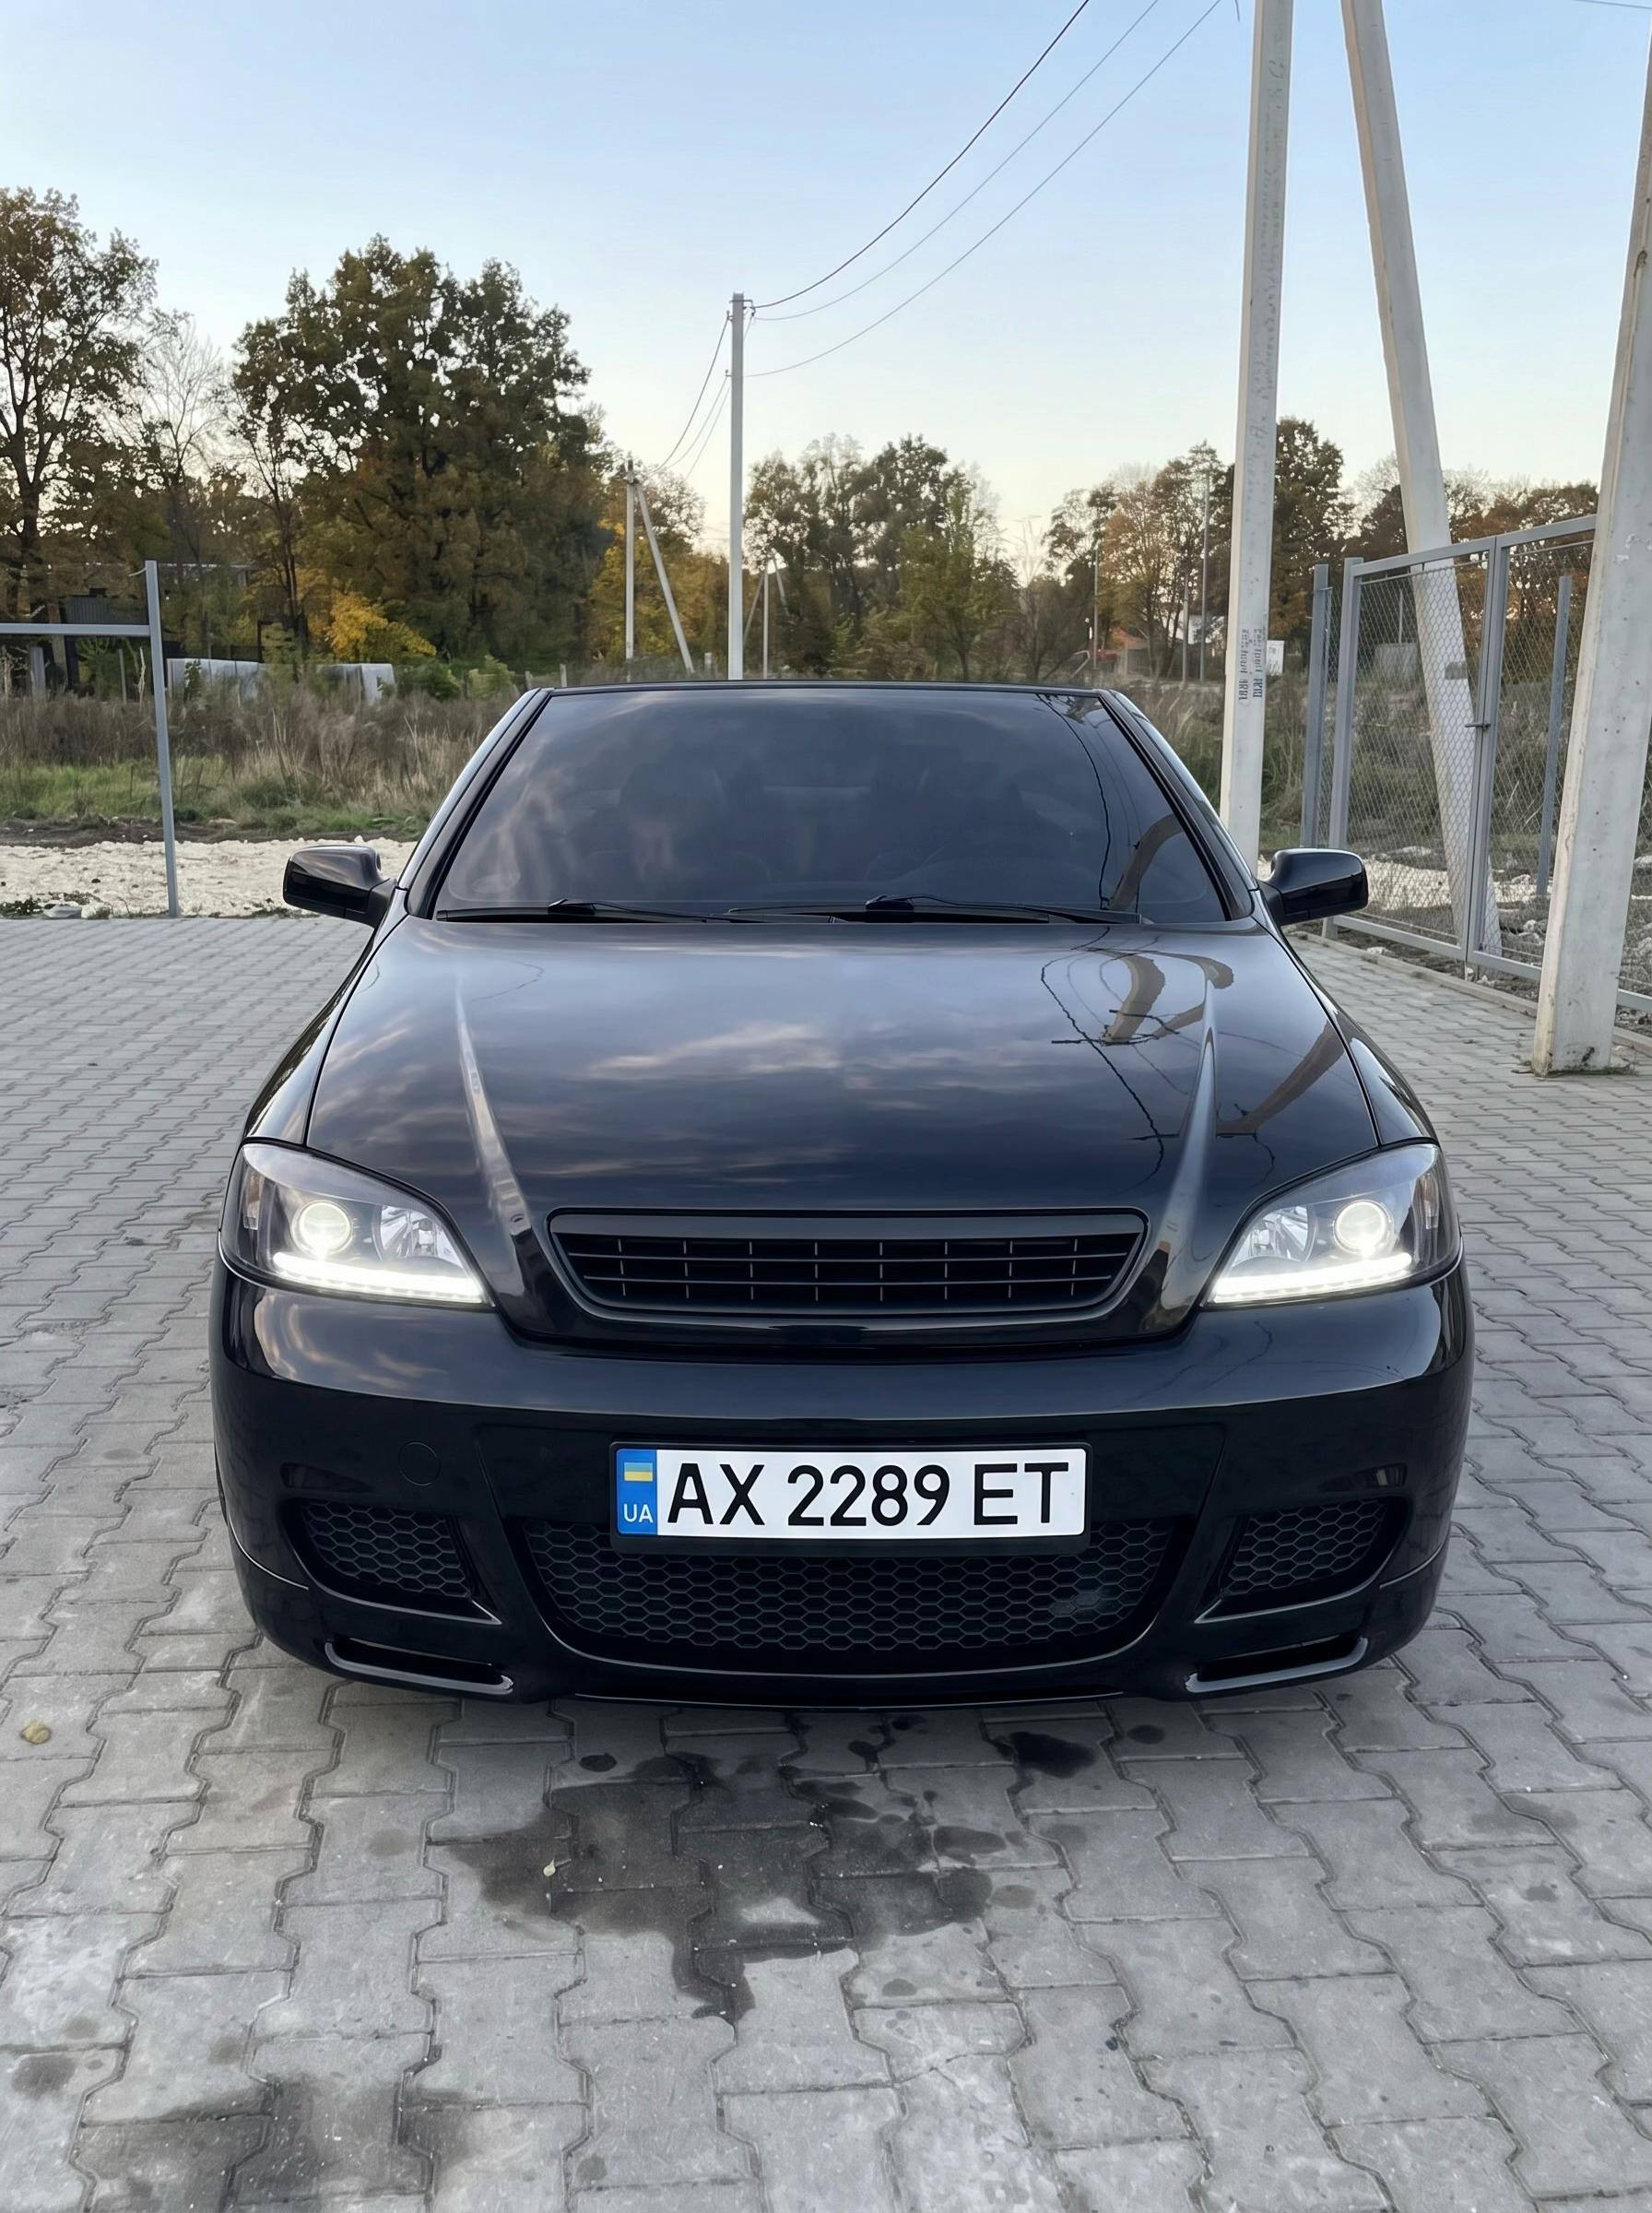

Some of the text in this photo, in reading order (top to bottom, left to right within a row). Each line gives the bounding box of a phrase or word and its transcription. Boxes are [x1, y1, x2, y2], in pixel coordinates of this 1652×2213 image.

[623, 1504, 654, 1523] UA
[667, 1462, 1069, 1527] AX 2289 ET
